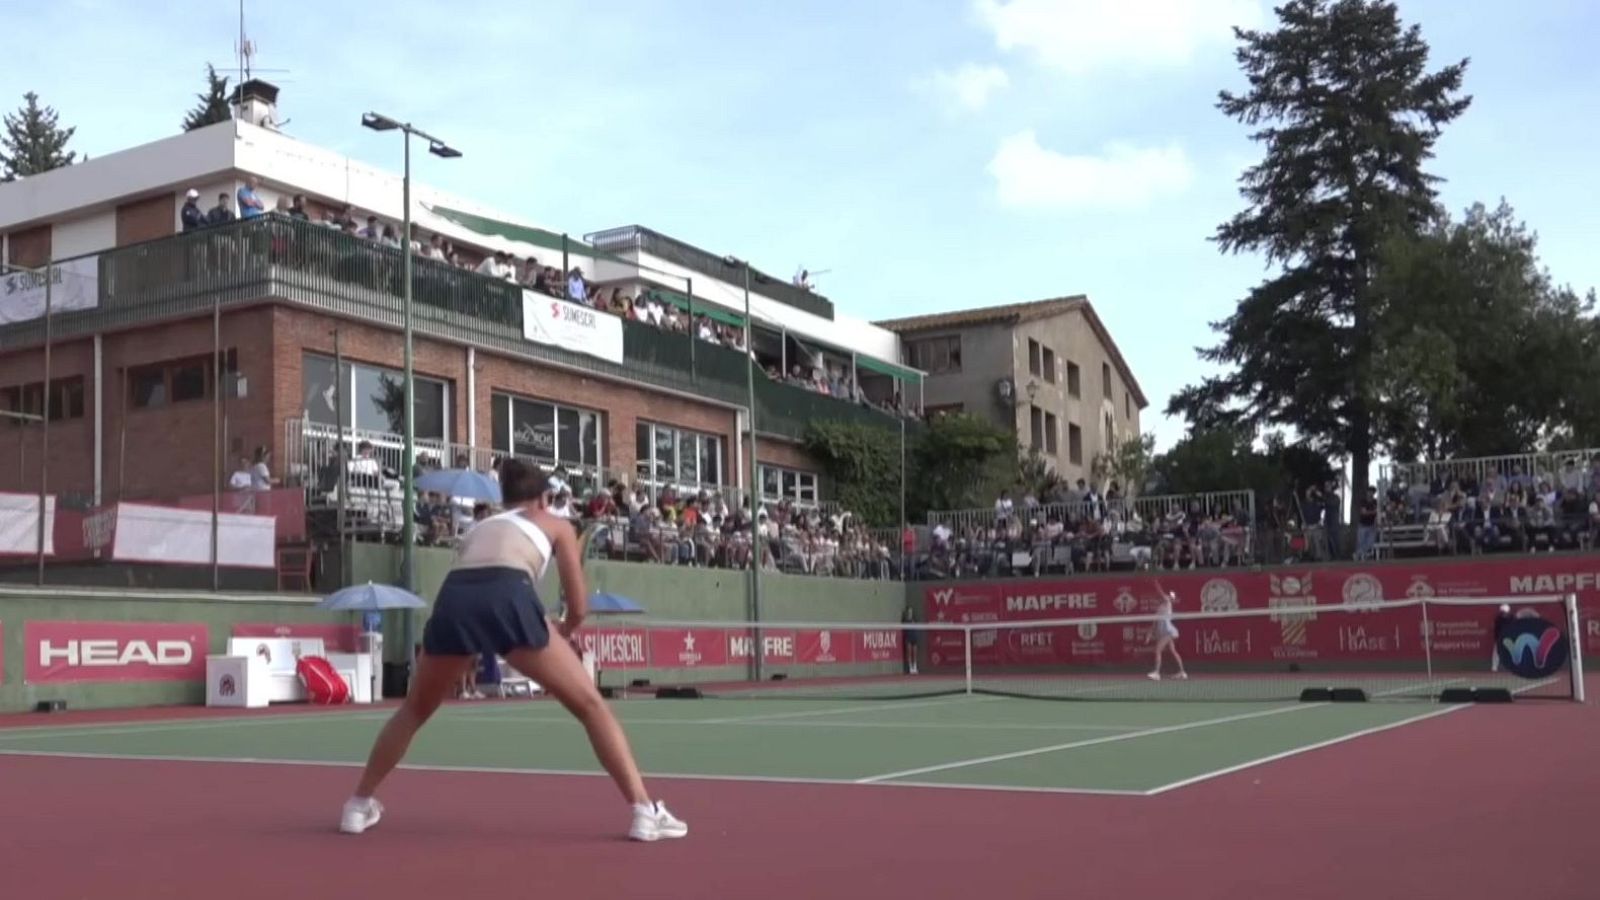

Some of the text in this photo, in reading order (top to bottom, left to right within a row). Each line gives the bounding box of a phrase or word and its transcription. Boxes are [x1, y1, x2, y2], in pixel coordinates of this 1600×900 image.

[1510, 573, 1600, 593] MAPF
[1006, 592, 1097, 611] MAPFRE
[730, 636, 793, 657] MAFRE
[1020, 631, 1053, 646] RFET
[39, 639, 192, 667] HEAD
